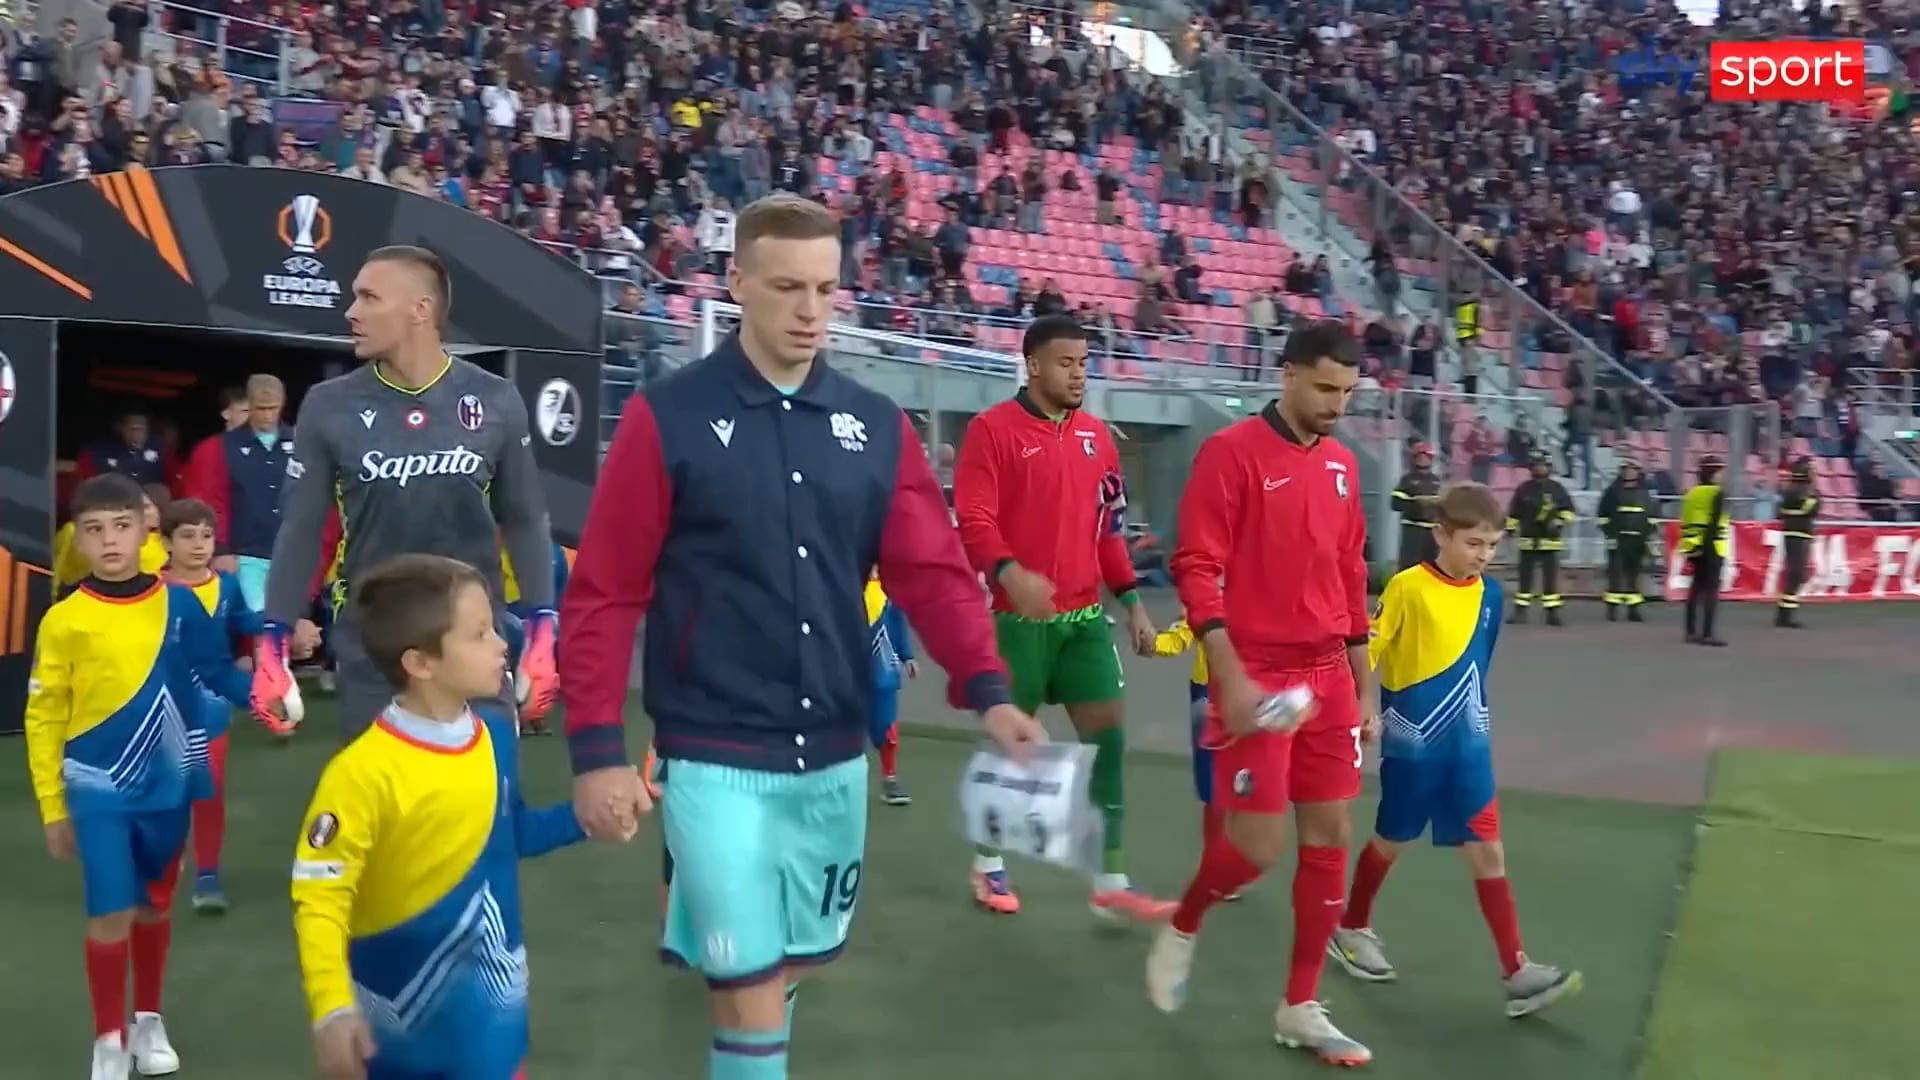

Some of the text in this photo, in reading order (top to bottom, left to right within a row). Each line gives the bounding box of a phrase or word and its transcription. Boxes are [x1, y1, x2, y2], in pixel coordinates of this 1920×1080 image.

[263, 274, 343, 294] EUROPA
[269, 290, 341, 308] LEAGUE
[358, 445, 484, 488] Saputo
[820, 861, 861, 916] 19
